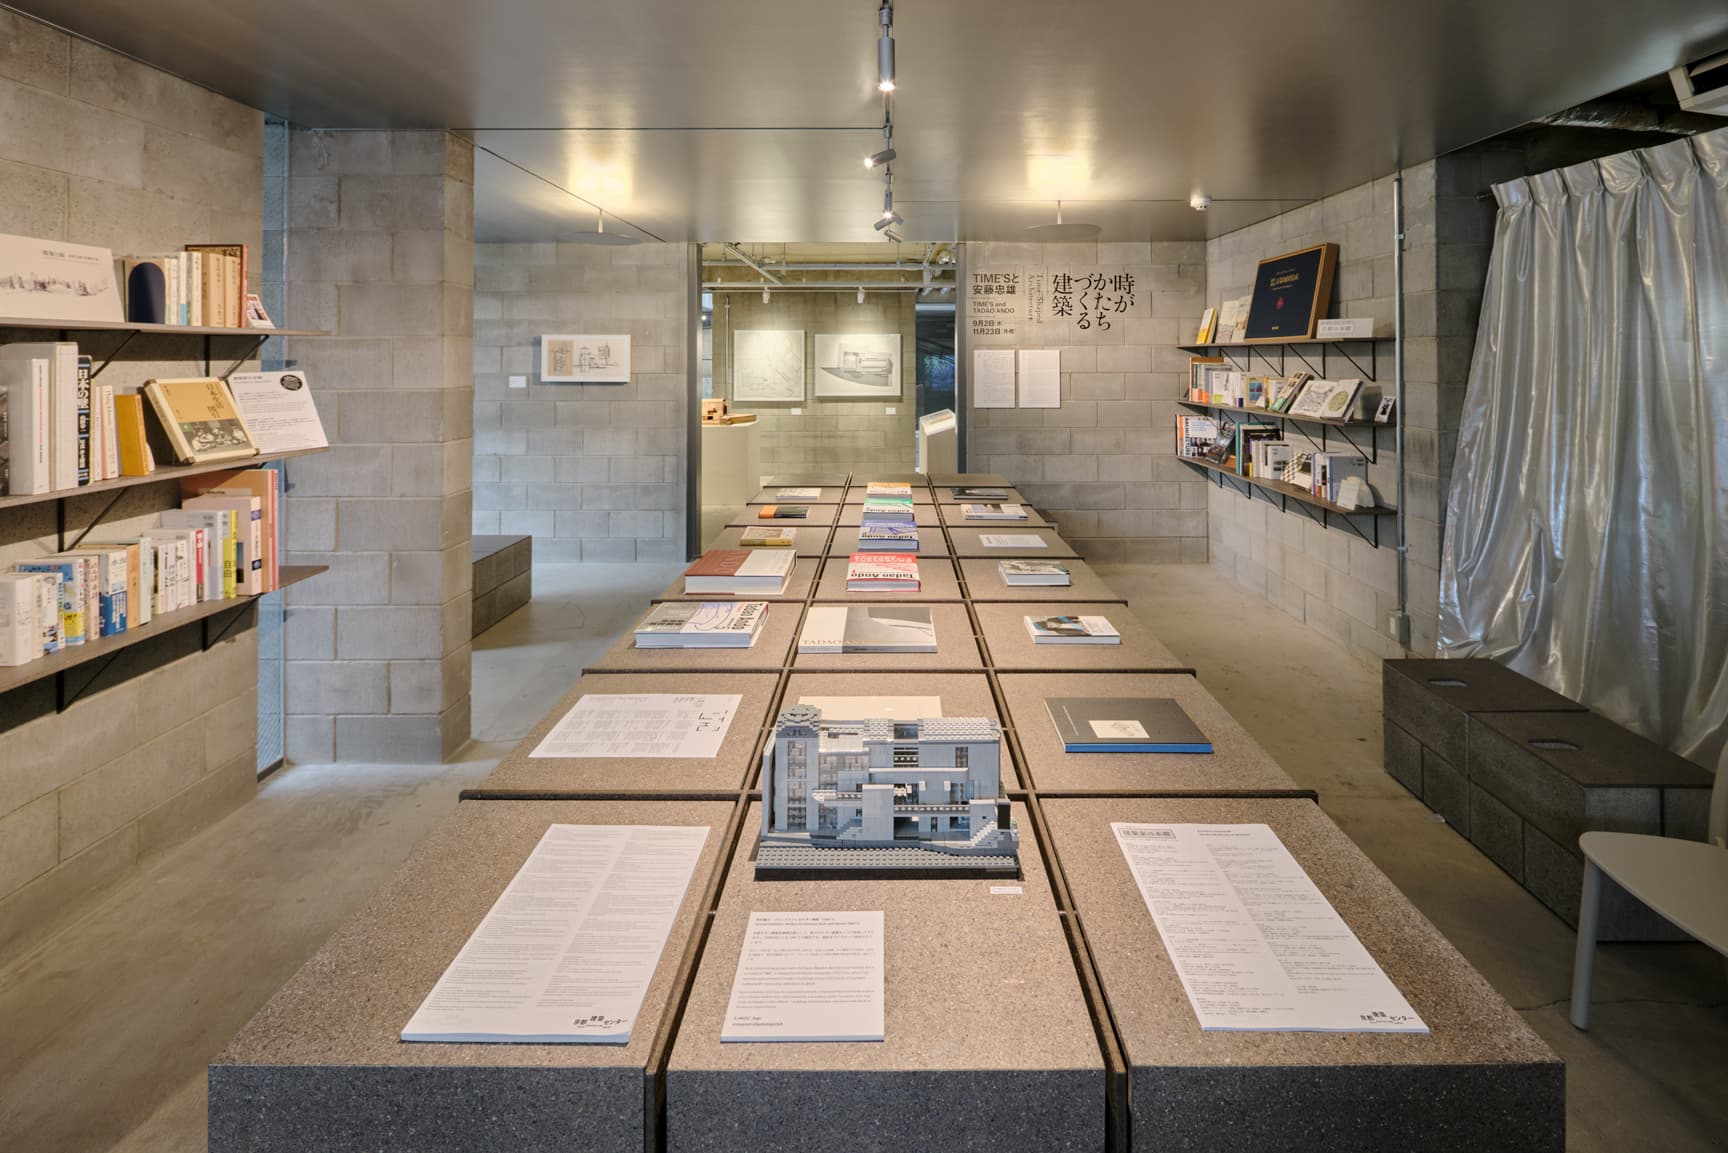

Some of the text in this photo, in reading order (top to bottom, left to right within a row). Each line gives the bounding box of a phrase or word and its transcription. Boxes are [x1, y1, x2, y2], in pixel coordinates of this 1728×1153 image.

[972, 273, 1019, 284] TIME'Sと
[972, 284, 1017, 295] 安藤忠雄
[1052, 273, 1073, 317] 建築
[1074, 273, 1094, 330] づくる
[1093, 273, 1113, 331] かたち
[1113, 273, 1135, 313] 時が
[972, 319, 995, 327] 9月2日
[973, 327, 1001, 335] 11月23日
